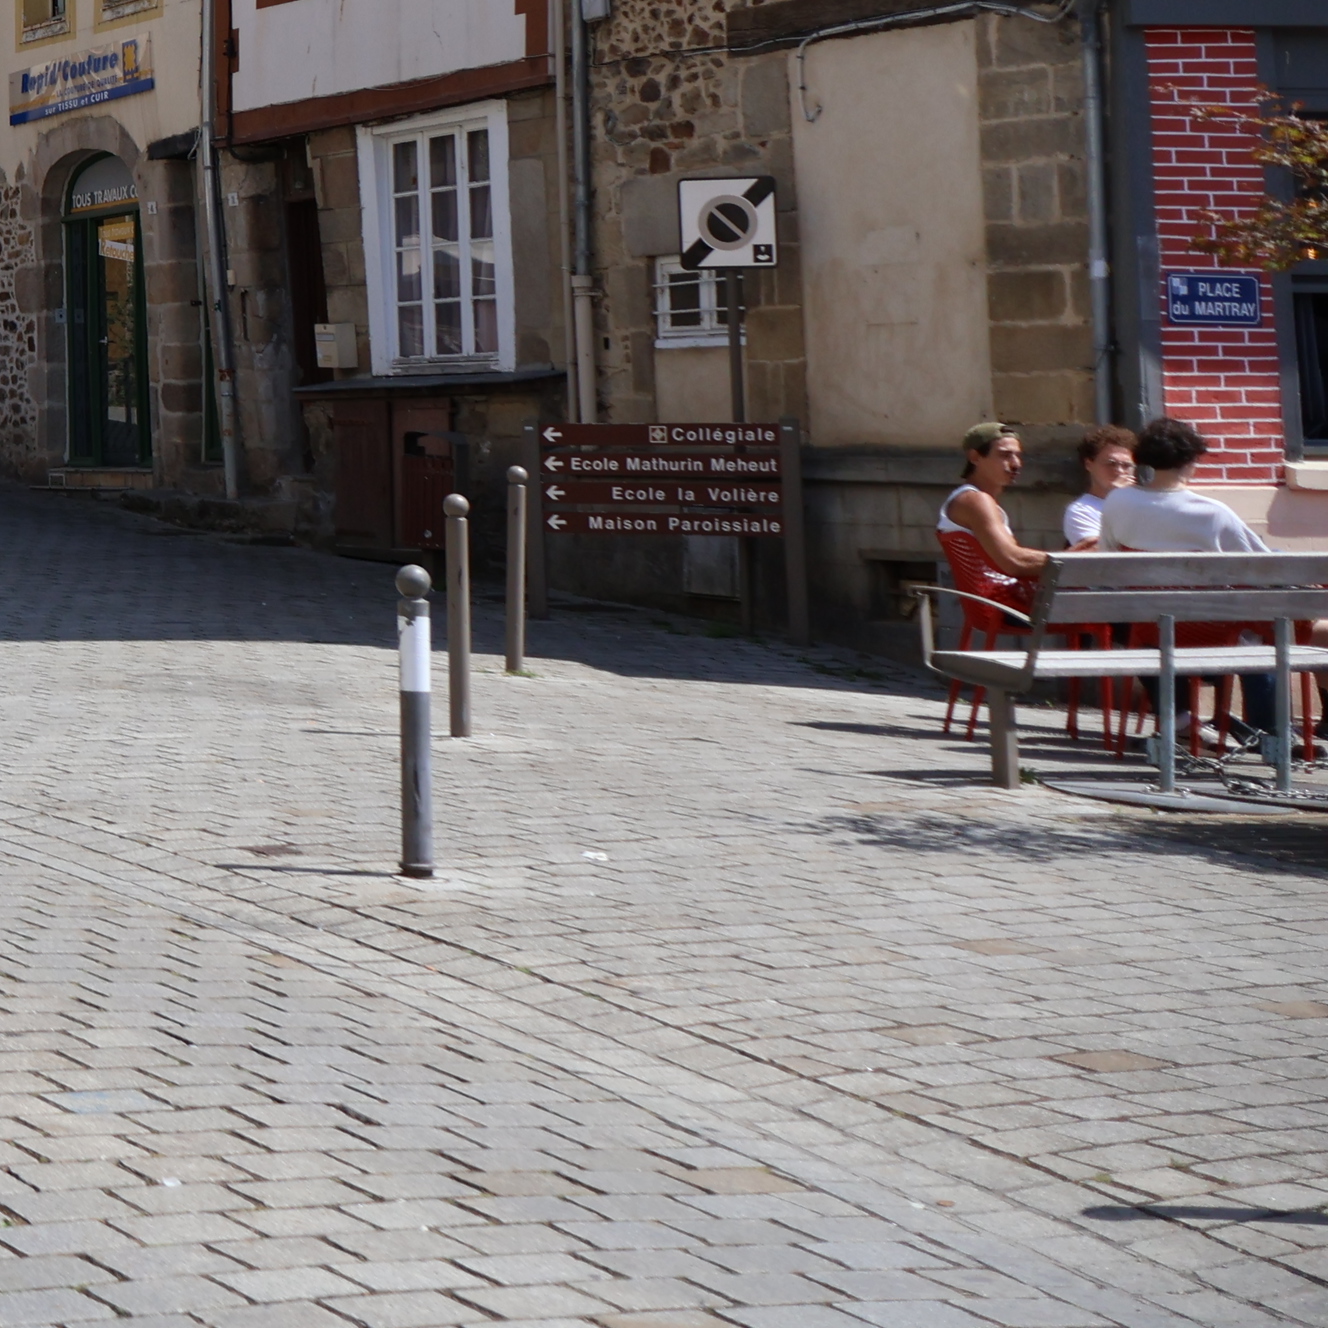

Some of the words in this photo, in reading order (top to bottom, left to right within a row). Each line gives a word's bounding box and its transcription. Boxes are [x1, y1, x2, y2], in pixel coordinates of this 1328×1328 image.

[45, 106, 57, 115] sur
[57, 99, 79, 112] TISSU
[80, 97, 88, 106] et
[90, 91, 109, 103] CUIR
[72, 193, 92, 209] TOUS
[94, 185, 128, 205] TRAVAUX
[1198, 281, 1241, 298] PLACE
[1172, 301, 1189, 315] du
[1194, 301, 1256, 317] MARTRAY
[671, 427, 776, 445] Collégiale
[570, 457, 619, 471] Ecole
[626, 457, 704, 472] Mathurin
[611, 486, 666, 501] Ecole
[677, 487, 696, 501] la
[707, 487, 780, 503] Volière
[588, 516, 658, 531] Maison
[668, 516, 781, 533] Paroissiale
